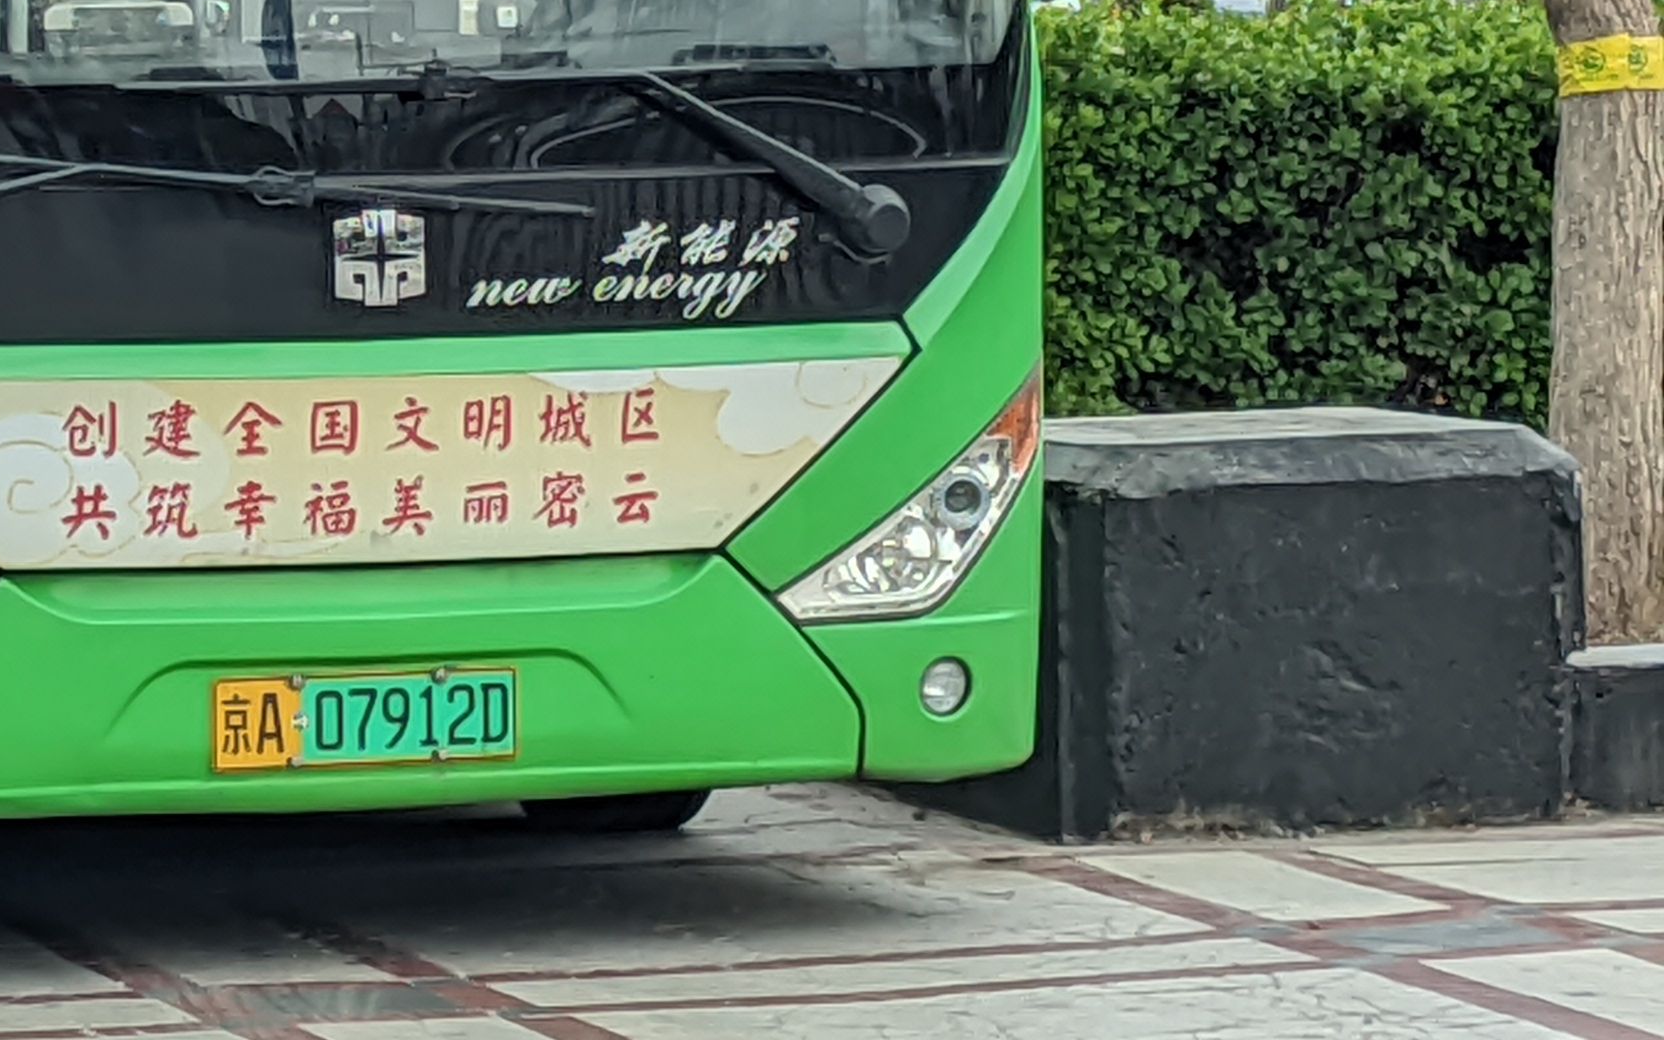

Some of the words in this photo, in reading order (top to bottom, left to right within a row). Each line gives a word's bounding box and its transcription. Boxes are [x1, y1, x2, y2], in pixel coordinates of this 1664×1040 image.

[602, 217, 800, 270] 新能源
[466, 271, 581, 308] new
[592, 266, 768, 321] energy
[61, 387, 661, 460] 创建全国文明城区
[61, 471, 660, 540] 共筑幸福美丽密云
